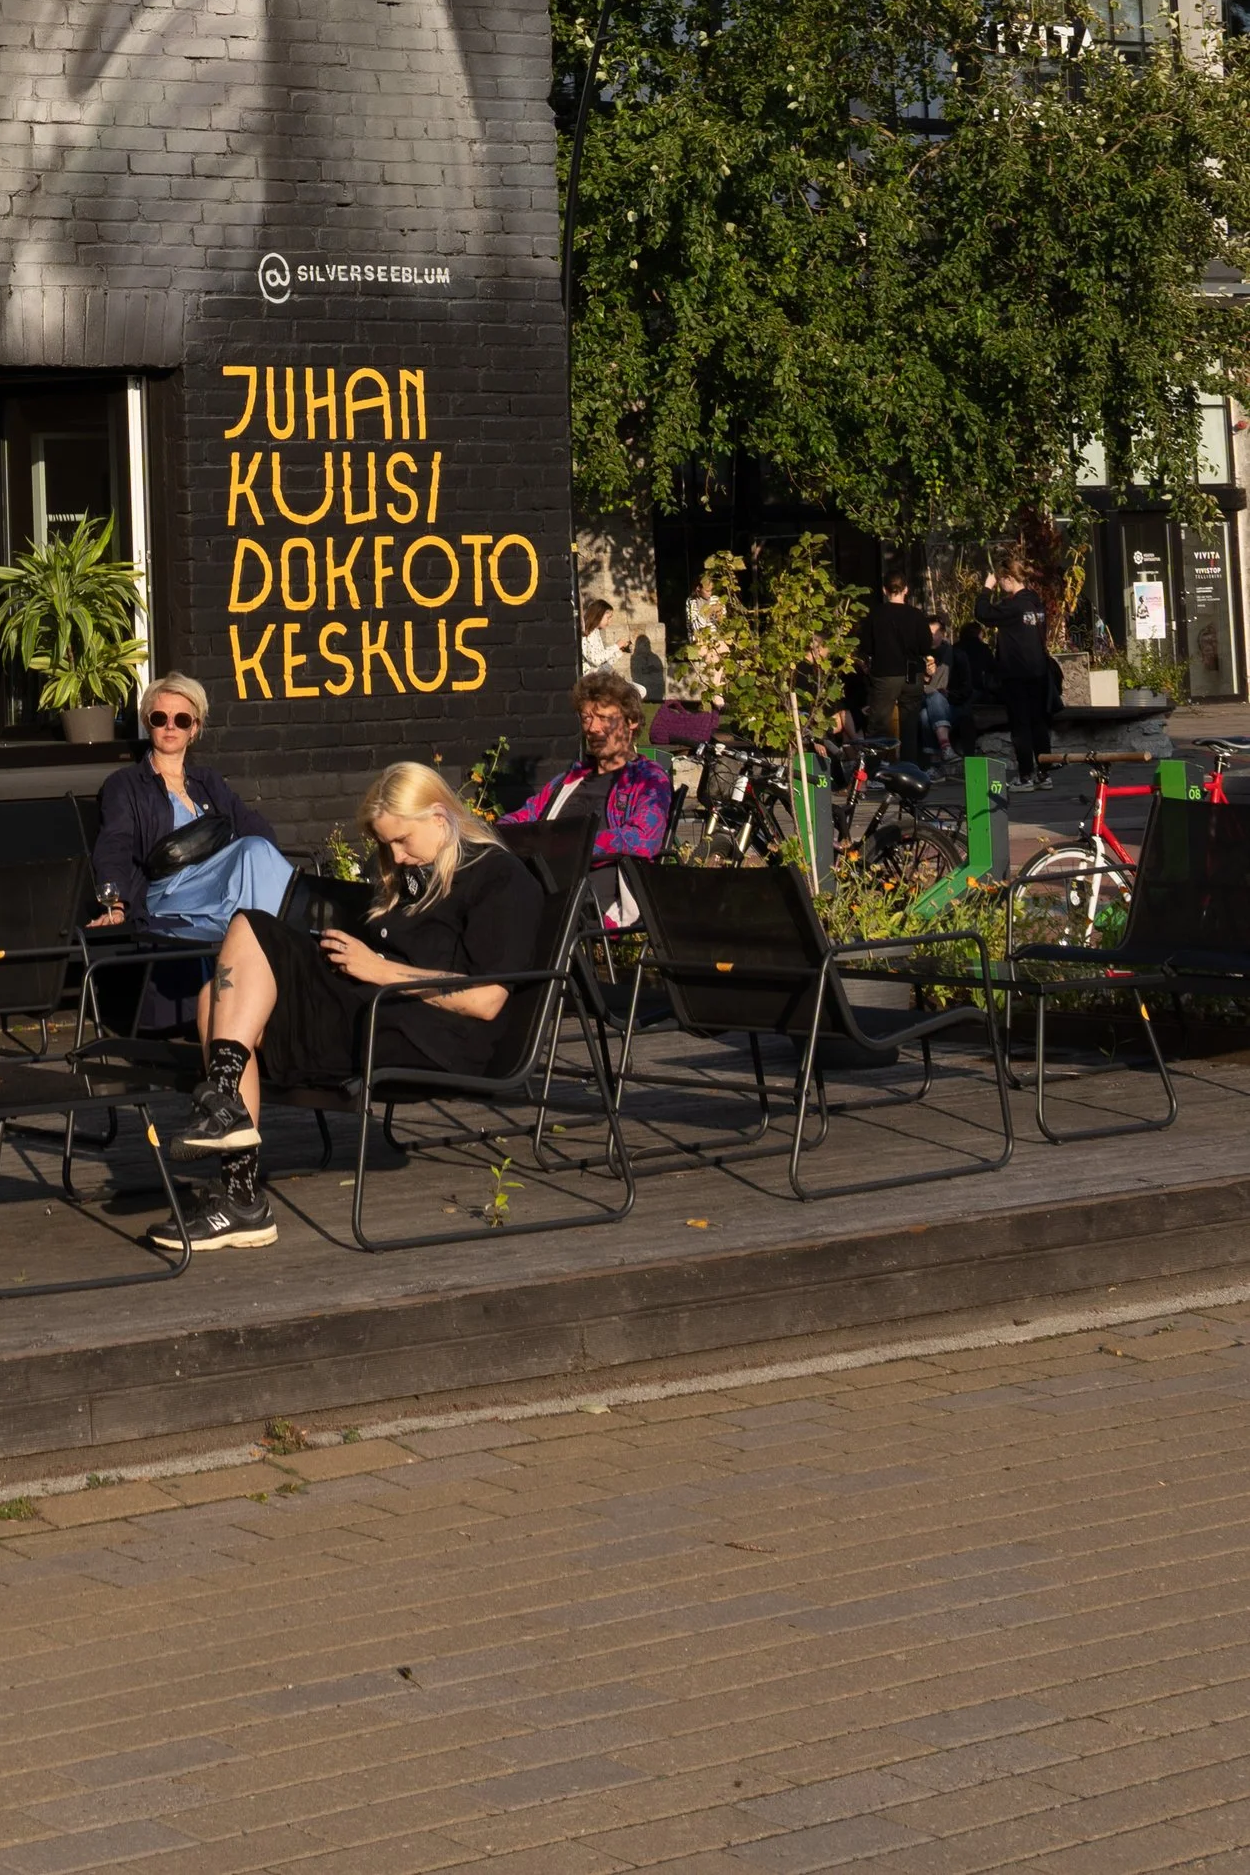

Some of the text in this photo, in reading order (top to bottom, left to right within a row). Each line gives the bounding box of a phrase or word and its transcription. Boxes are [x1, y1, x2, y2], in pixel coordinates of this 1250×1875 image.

[222, 365, 427, 440] JUHAN
[227, 451, 442, 526] KUUSI
[227, 533, 539, 613] DOKFOTO
[1193, 551, 1221, 560] VIVITA
[229, 617, 490, 700] KESKUS
[990, 783, 1003, 794] 07
[1188, 789, 1202, 800] 08
